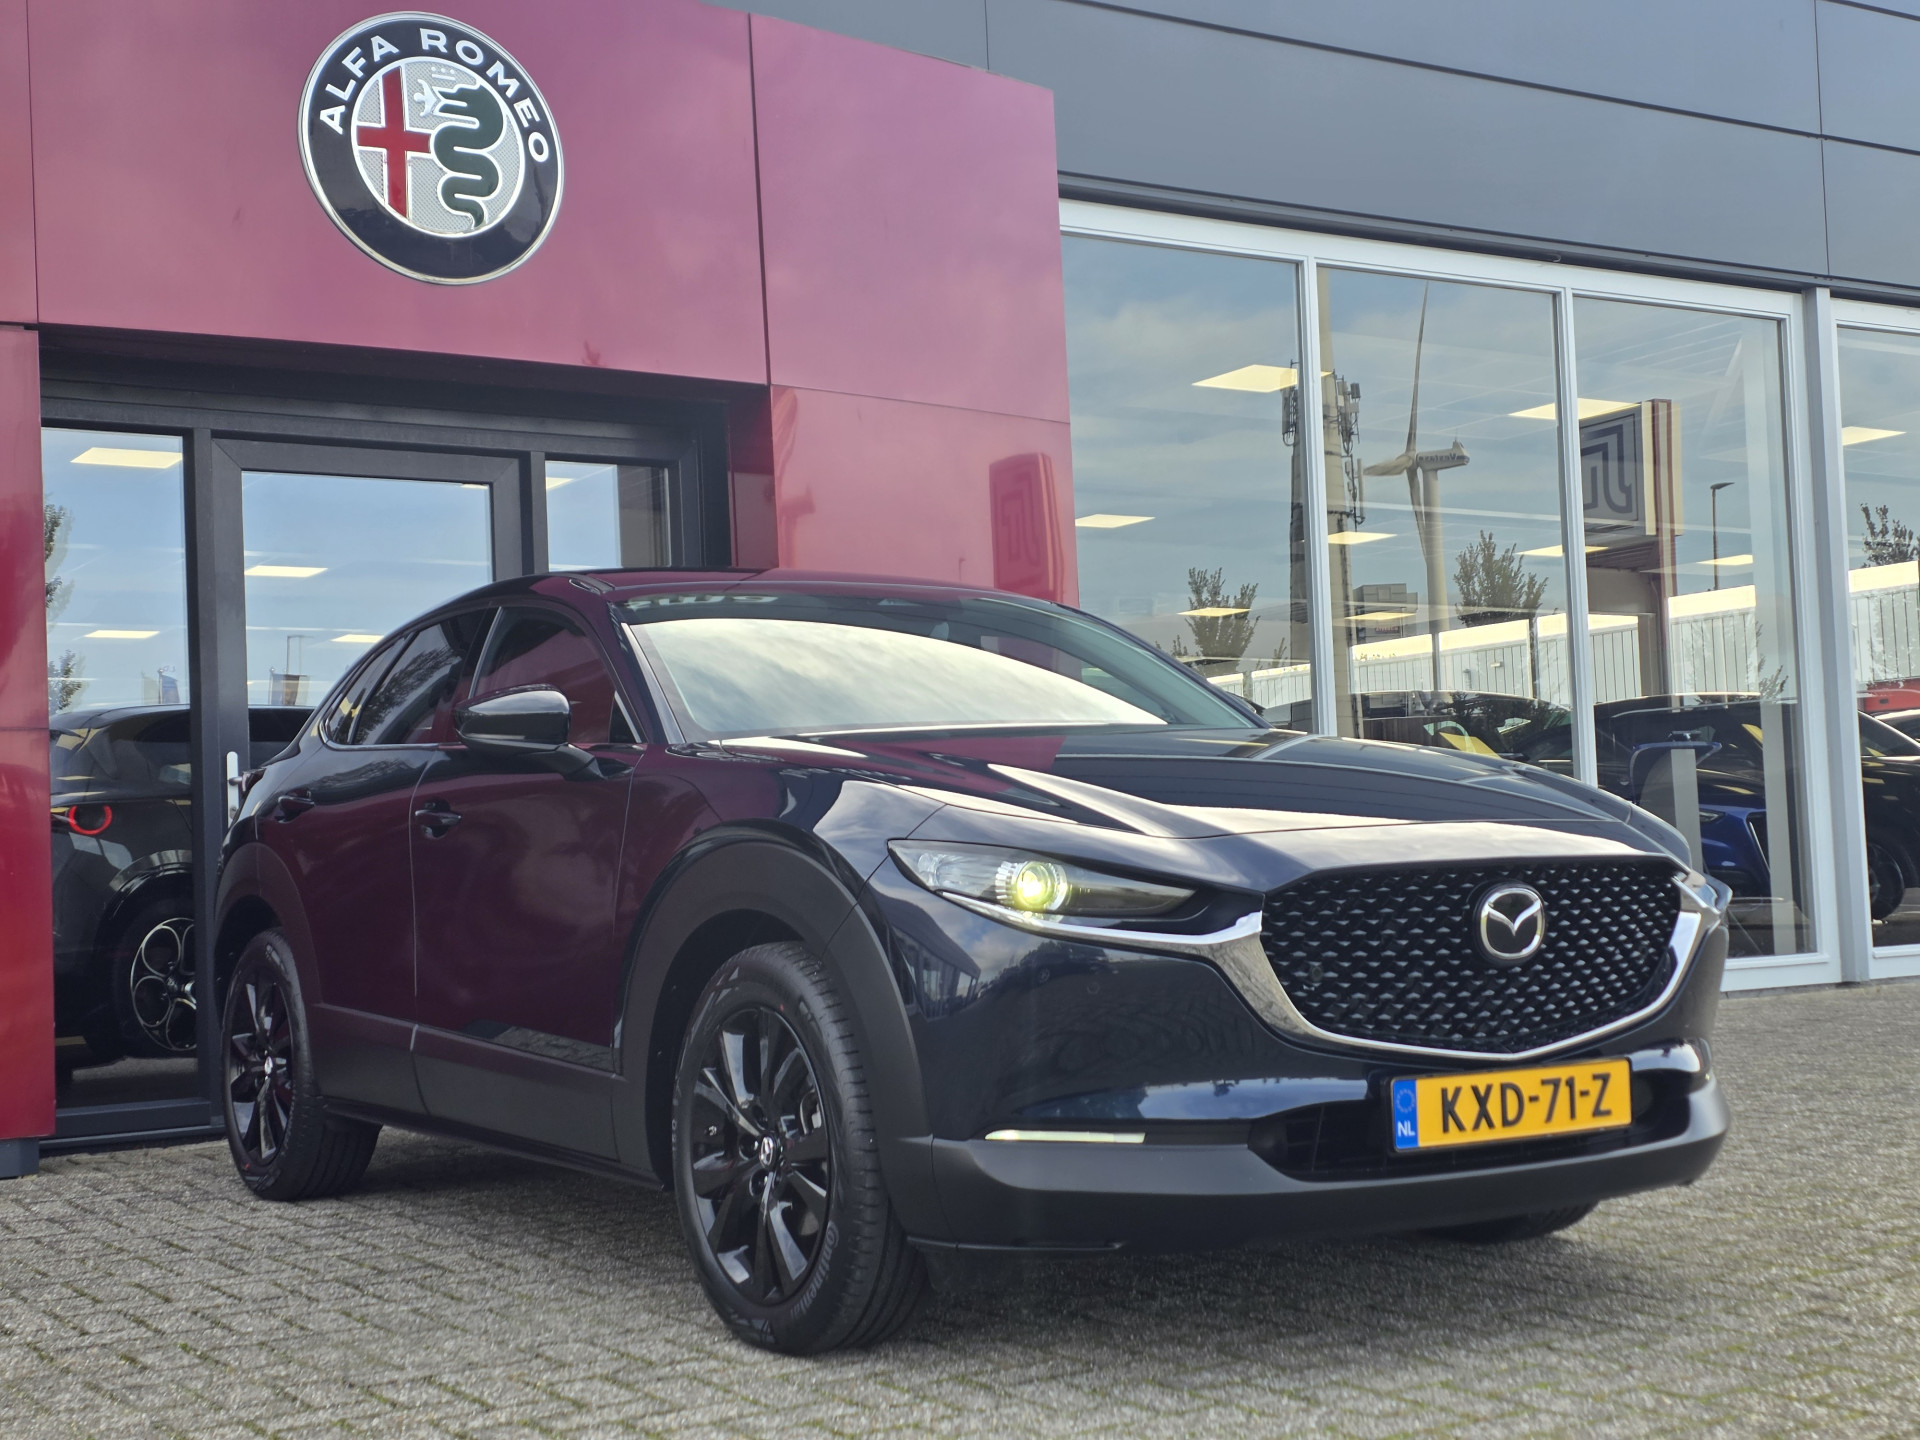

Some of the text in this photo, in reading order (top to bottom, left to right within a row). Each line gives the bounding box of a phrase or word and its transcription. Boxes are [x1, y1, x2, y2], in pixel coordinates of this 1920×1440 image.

[319, 28, 549, 162] ALFA ROMEO
[1398, 1073, 1612, 1136] NL KXD-71-Z
